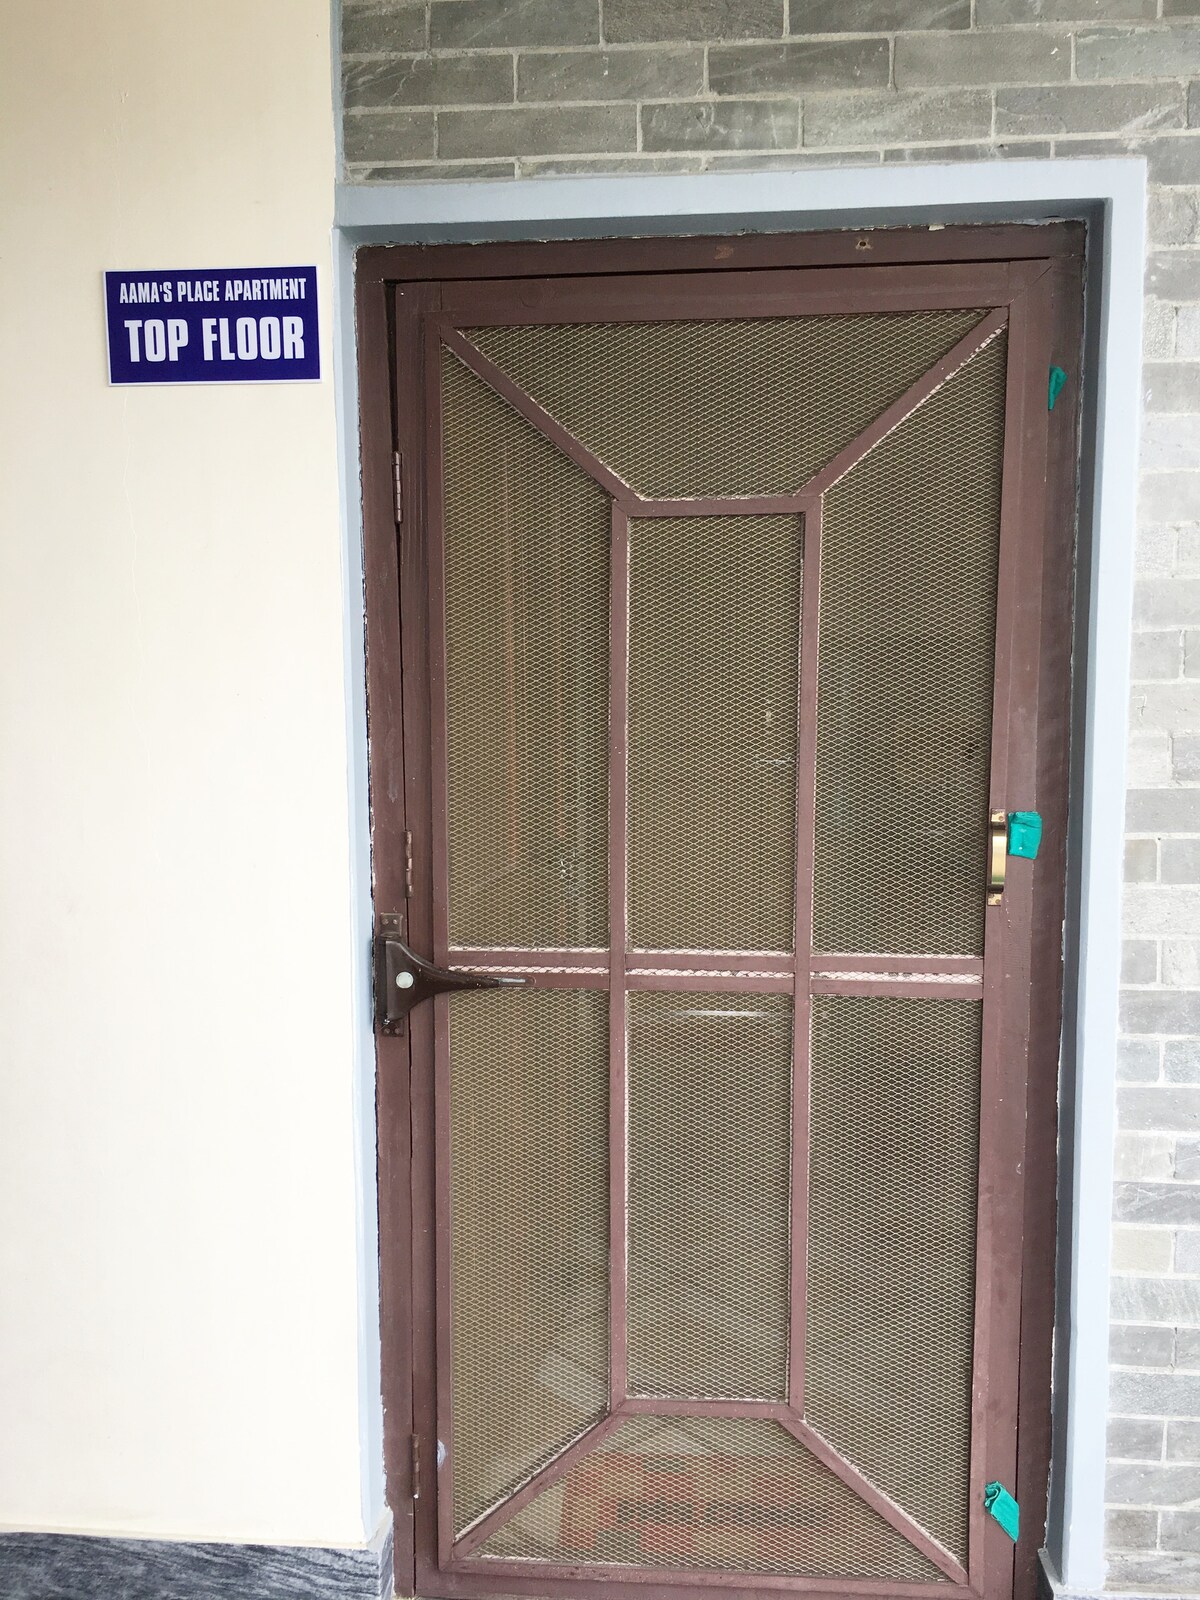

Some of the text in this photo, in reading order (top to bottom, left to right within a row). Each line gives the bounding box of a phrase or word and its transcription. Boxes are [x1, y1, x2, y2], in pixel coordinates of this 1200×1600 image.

[119, 278, 306, 304] AAMA'S PLACE APARTMENT
[124, 316, 305, 363] TOP FLOOR
